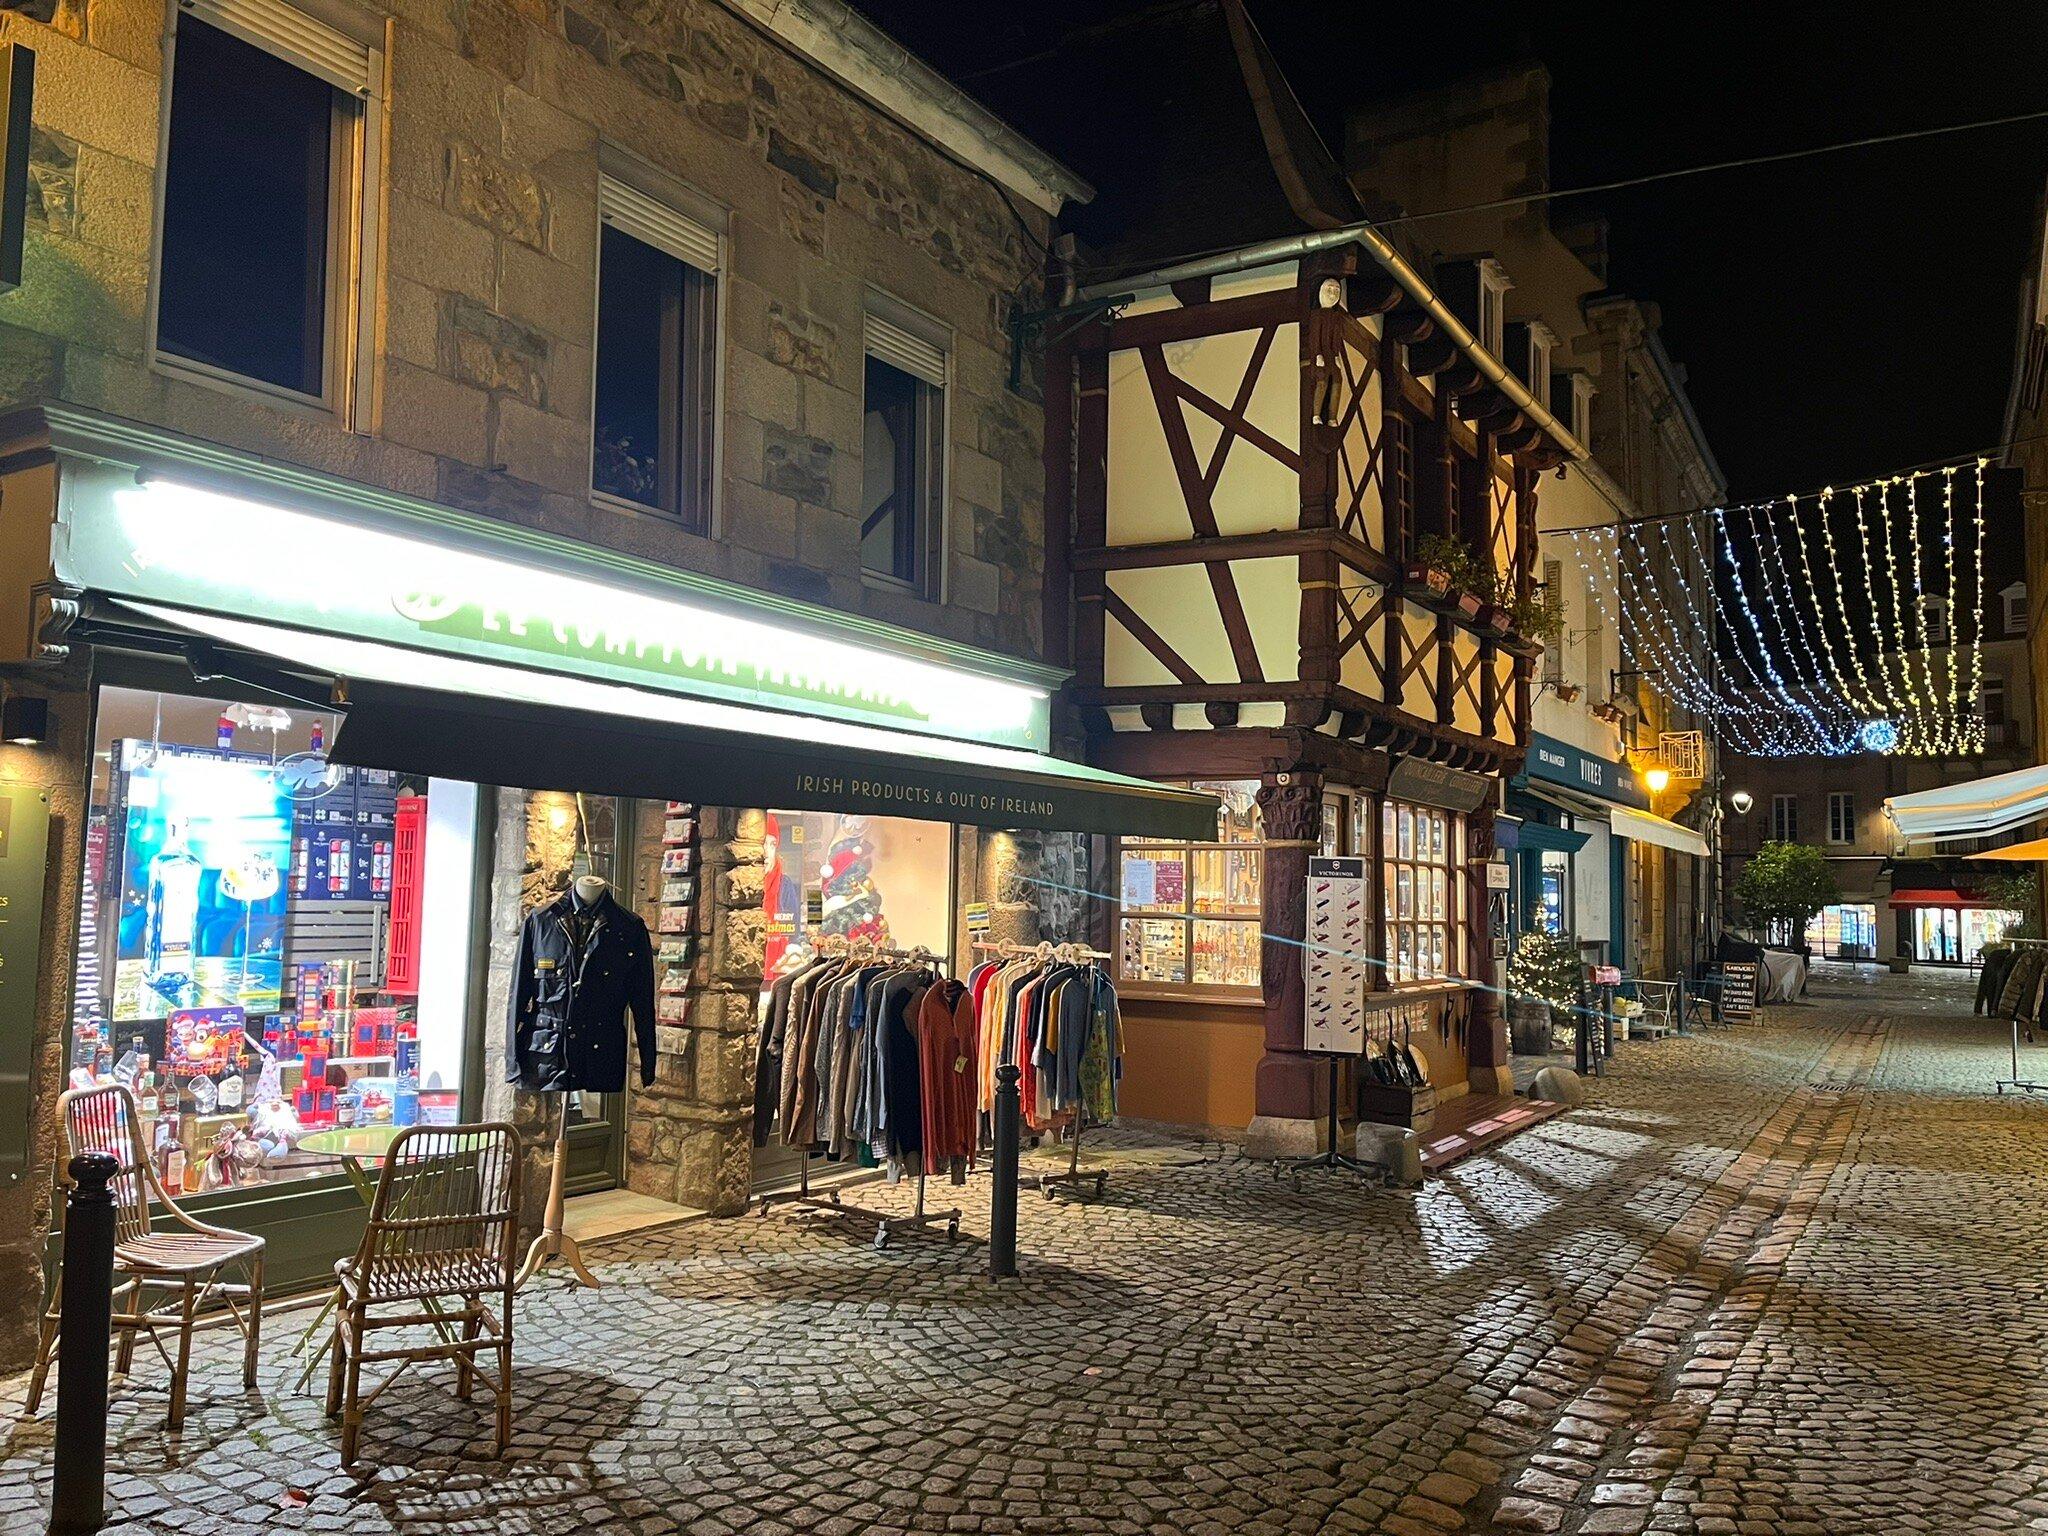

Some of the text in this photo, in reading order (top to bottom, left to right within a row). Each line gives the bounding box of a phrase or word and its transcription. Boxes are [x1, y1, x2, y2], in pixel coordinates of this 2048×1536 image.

[797, 775, 1054, 816] IRISH PRODUCTS & OUT OF IRELAND
